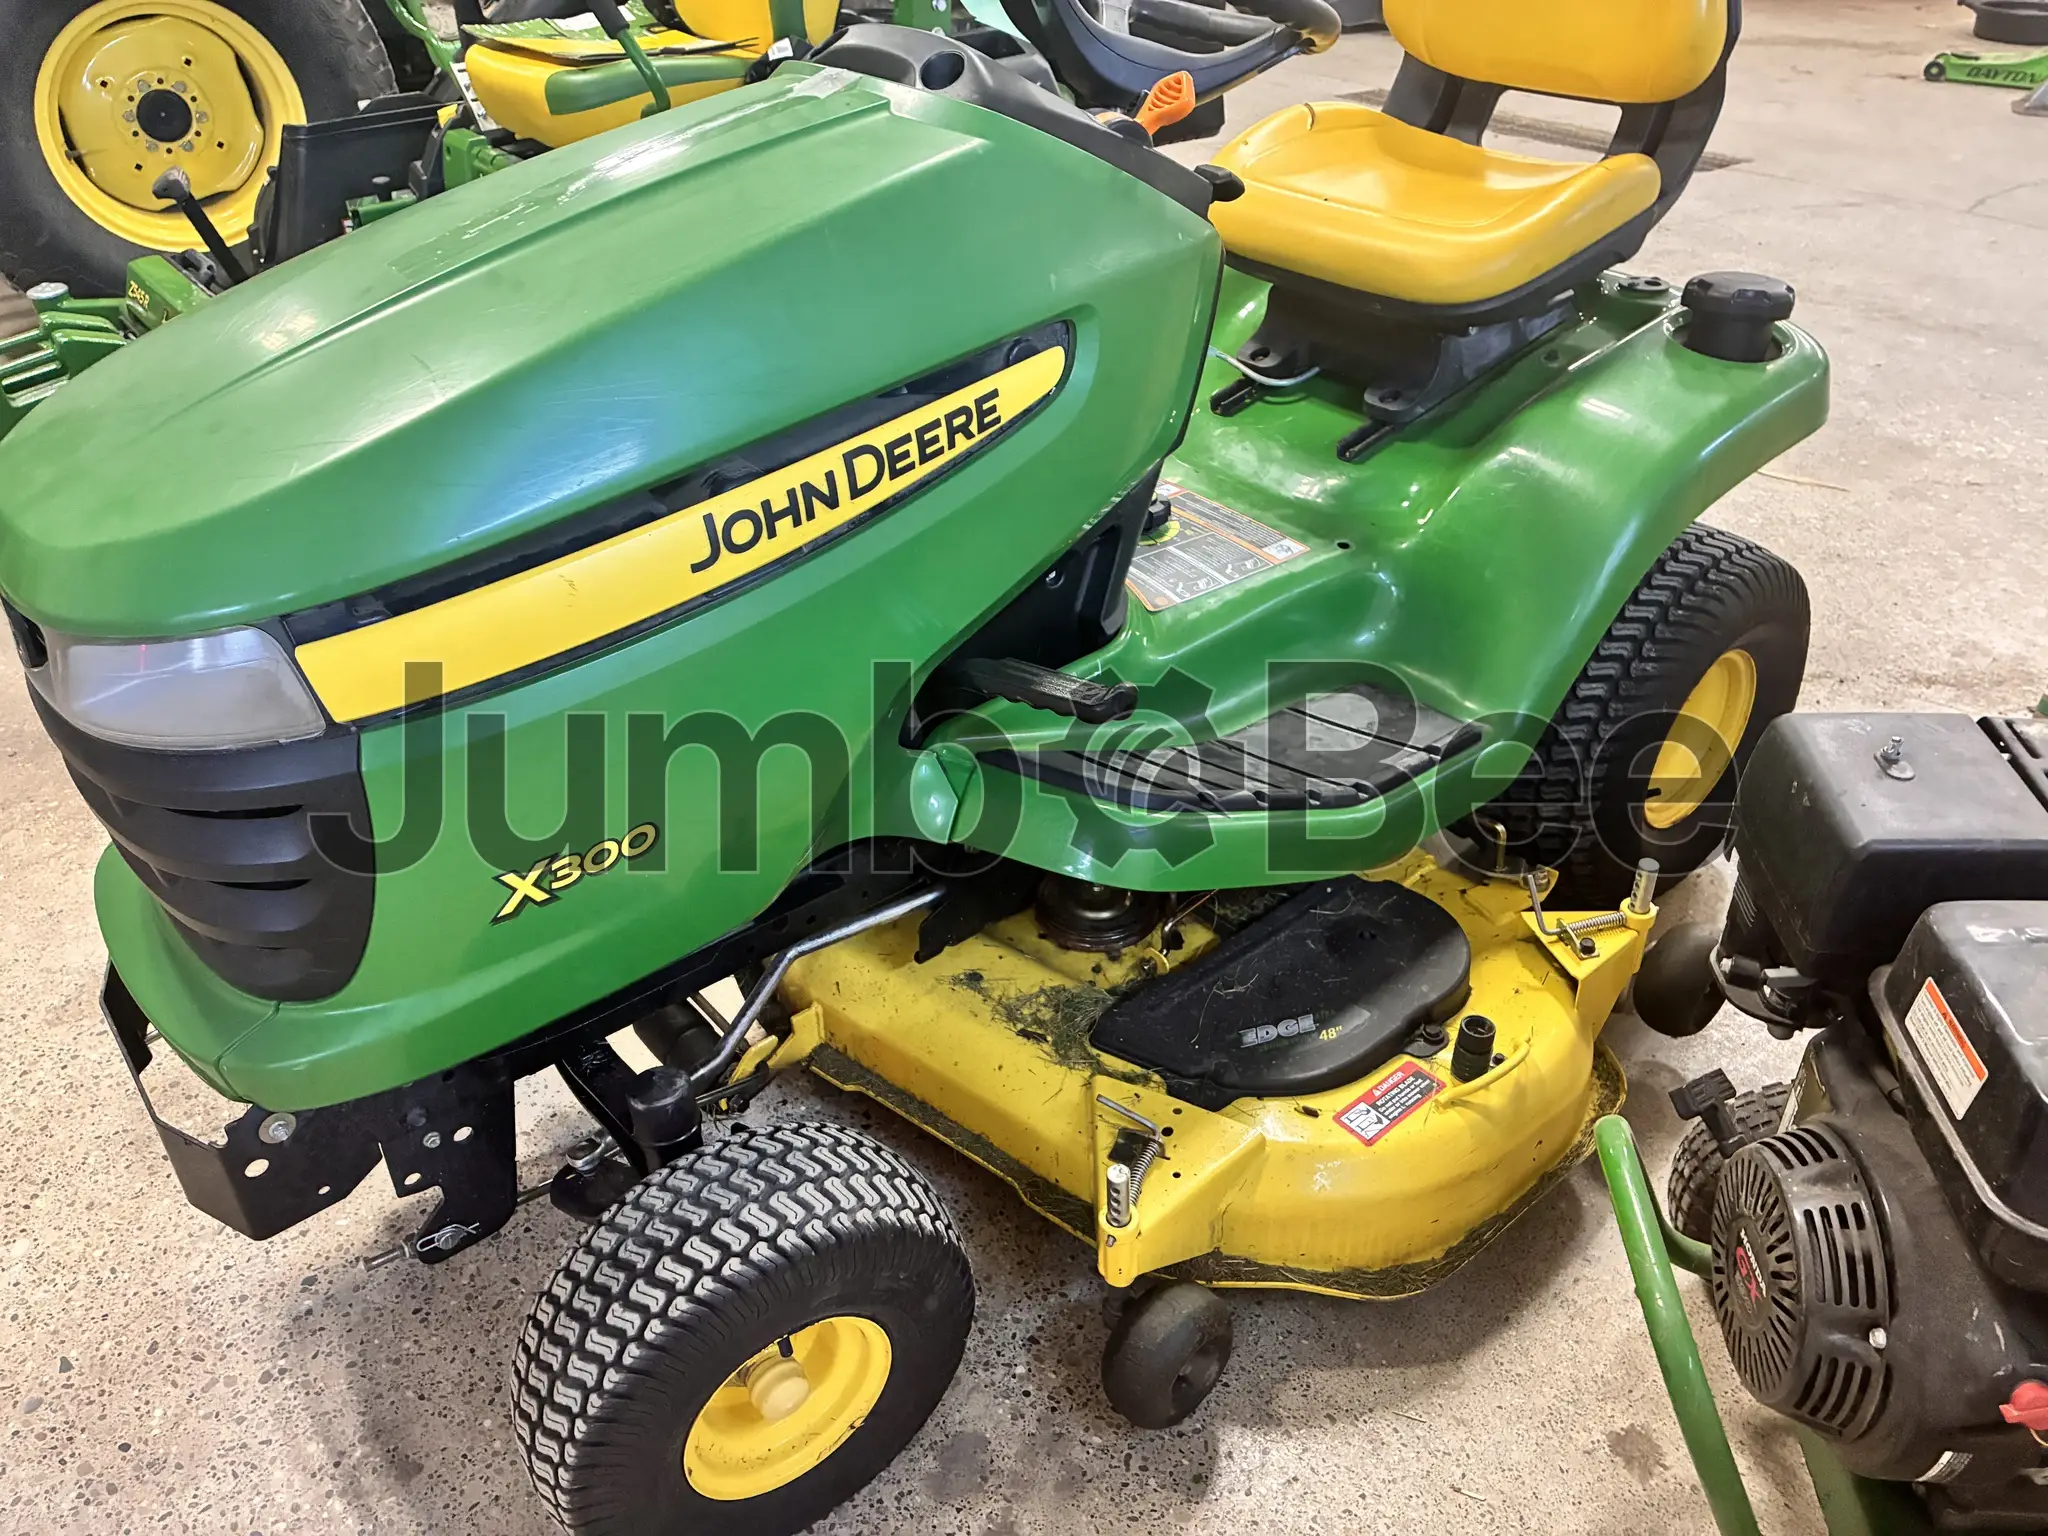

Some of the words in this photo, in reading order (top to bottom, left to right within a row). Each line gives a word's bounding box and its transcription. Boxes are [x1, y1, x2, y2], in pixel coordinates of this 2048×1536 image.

[690, 469, 840, 574] JOHN
[842, 388, 1002, 500] DEERE
[490, 822, 660, 925] X300
[1239, 1014, 1316, 1048] EDGE
[1319, 1025, 1343, 1040] 48"
[1377, 1071, 1405, 1092] DANGER
[1735, 1246, 1763, 1305] GX
[1740, 1228, 1766, 1297] HONDA
